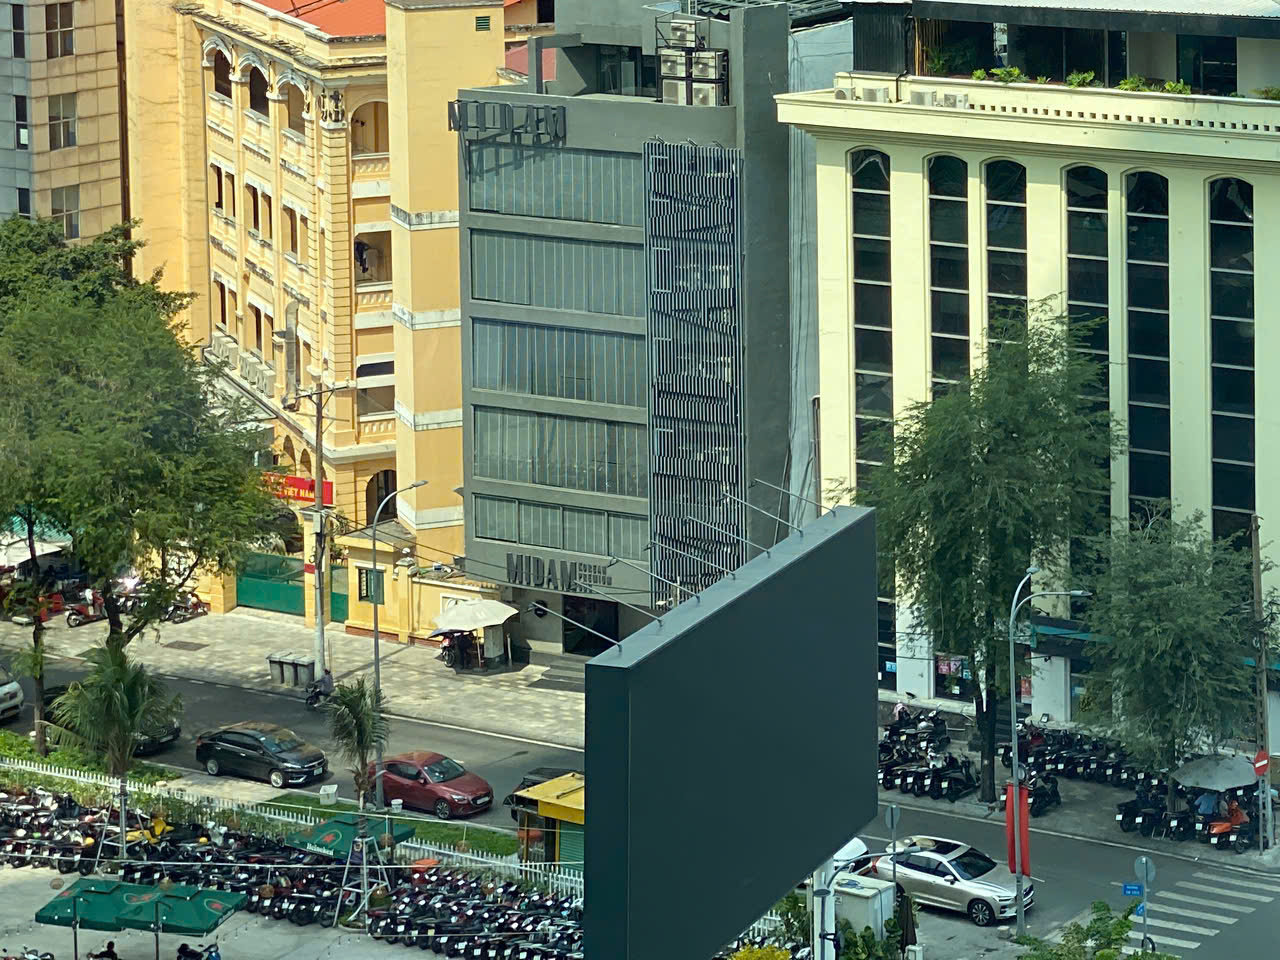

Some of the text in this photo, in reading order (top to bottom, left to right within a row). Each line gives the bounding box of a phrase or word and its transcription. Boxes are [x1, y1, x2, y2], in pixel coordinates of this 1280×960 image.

[448, 101, 566, 139] MIDAM
[506, 552, 577, 592] MIDAM
[306, 842, 335, 856] Heineken
